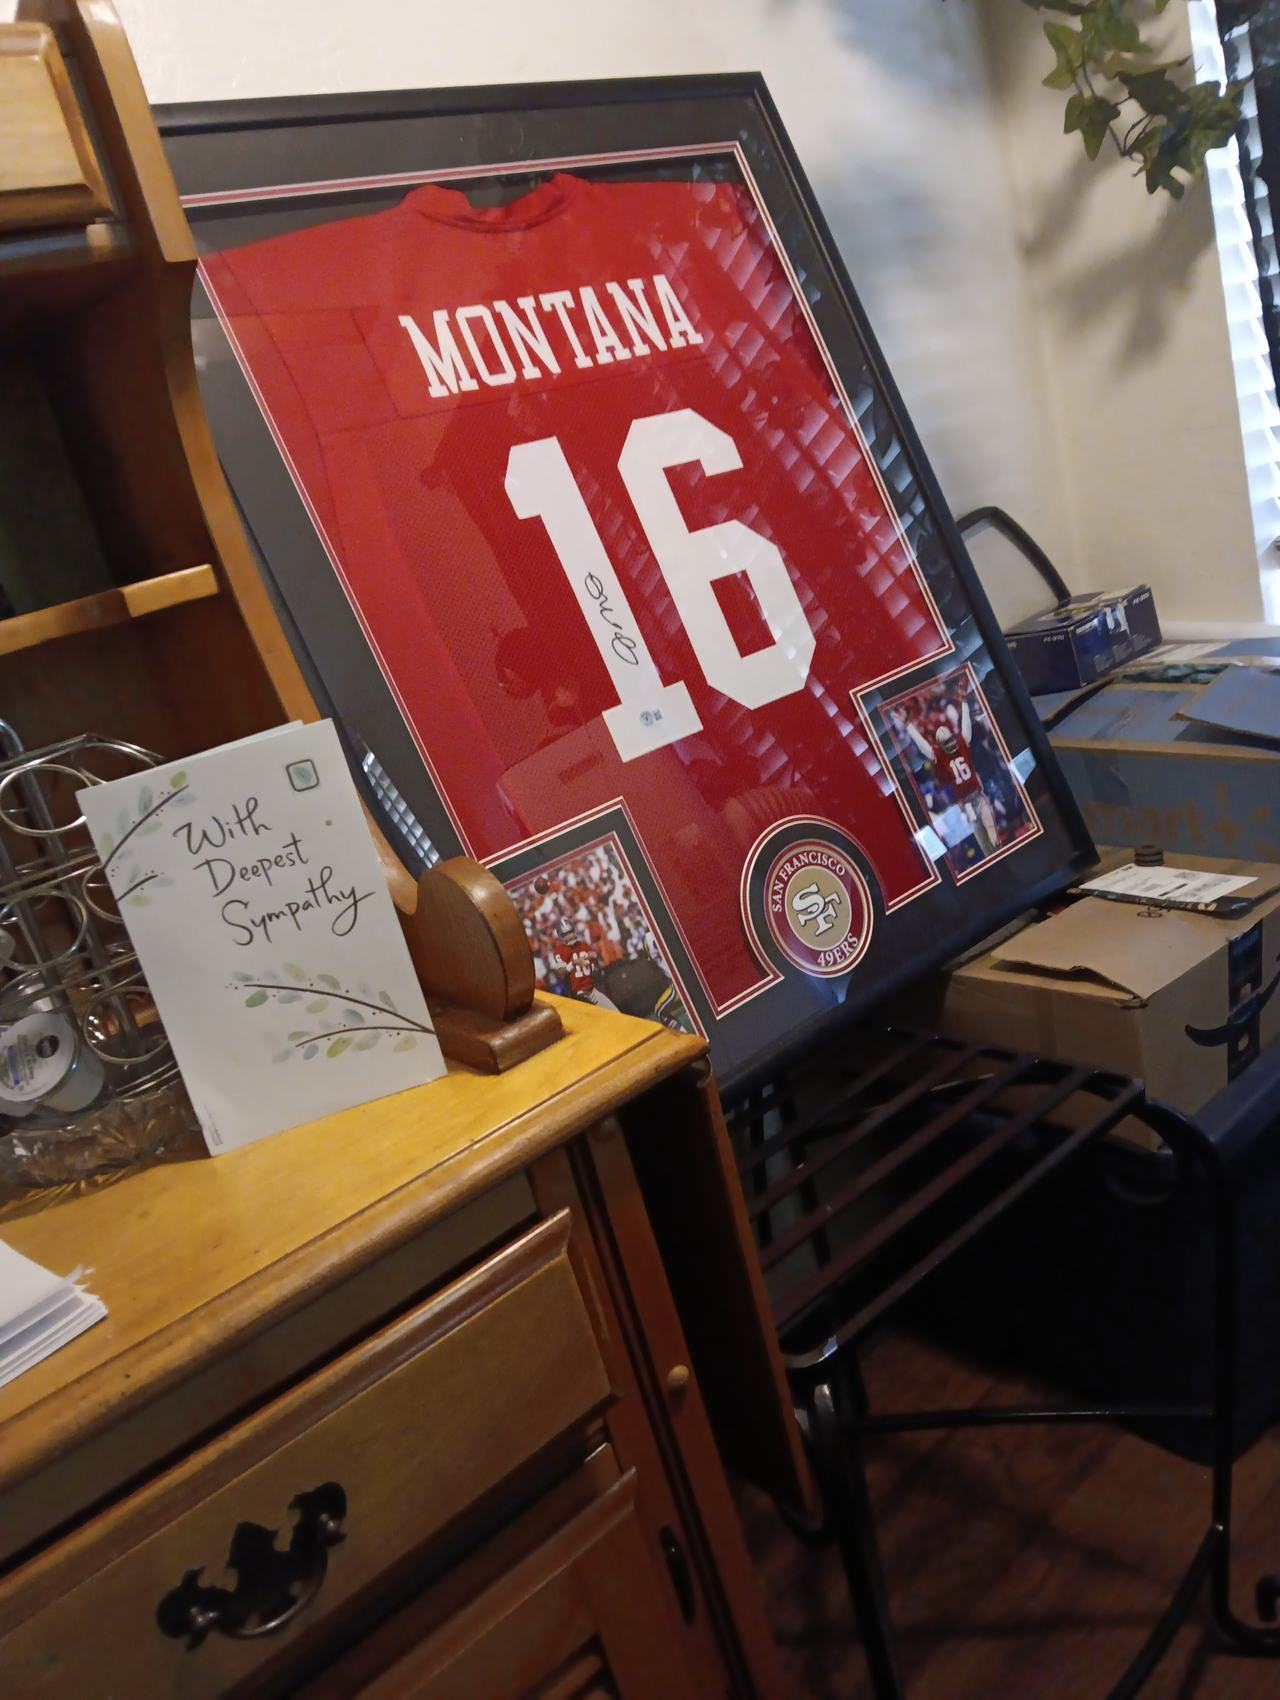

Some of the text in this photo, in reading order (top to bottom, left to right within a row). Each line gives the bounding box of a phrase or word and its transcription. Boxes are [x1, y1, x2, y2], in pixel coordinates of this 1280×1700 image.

[398, 274, 703, 398] MONTANA
[504, 408, 817, 763] 16
[949, 757, 972, 785] 16
[172, 797, 272, 856] With
[193, 833, 309, 897] Deepest
[773, 852, 846, 913] SAN FRANCISCO
[221, 866, 376, 946] Sympathy
[792, 882, 842, 936] SF
[817, 933, 859, 967] 49ERS
